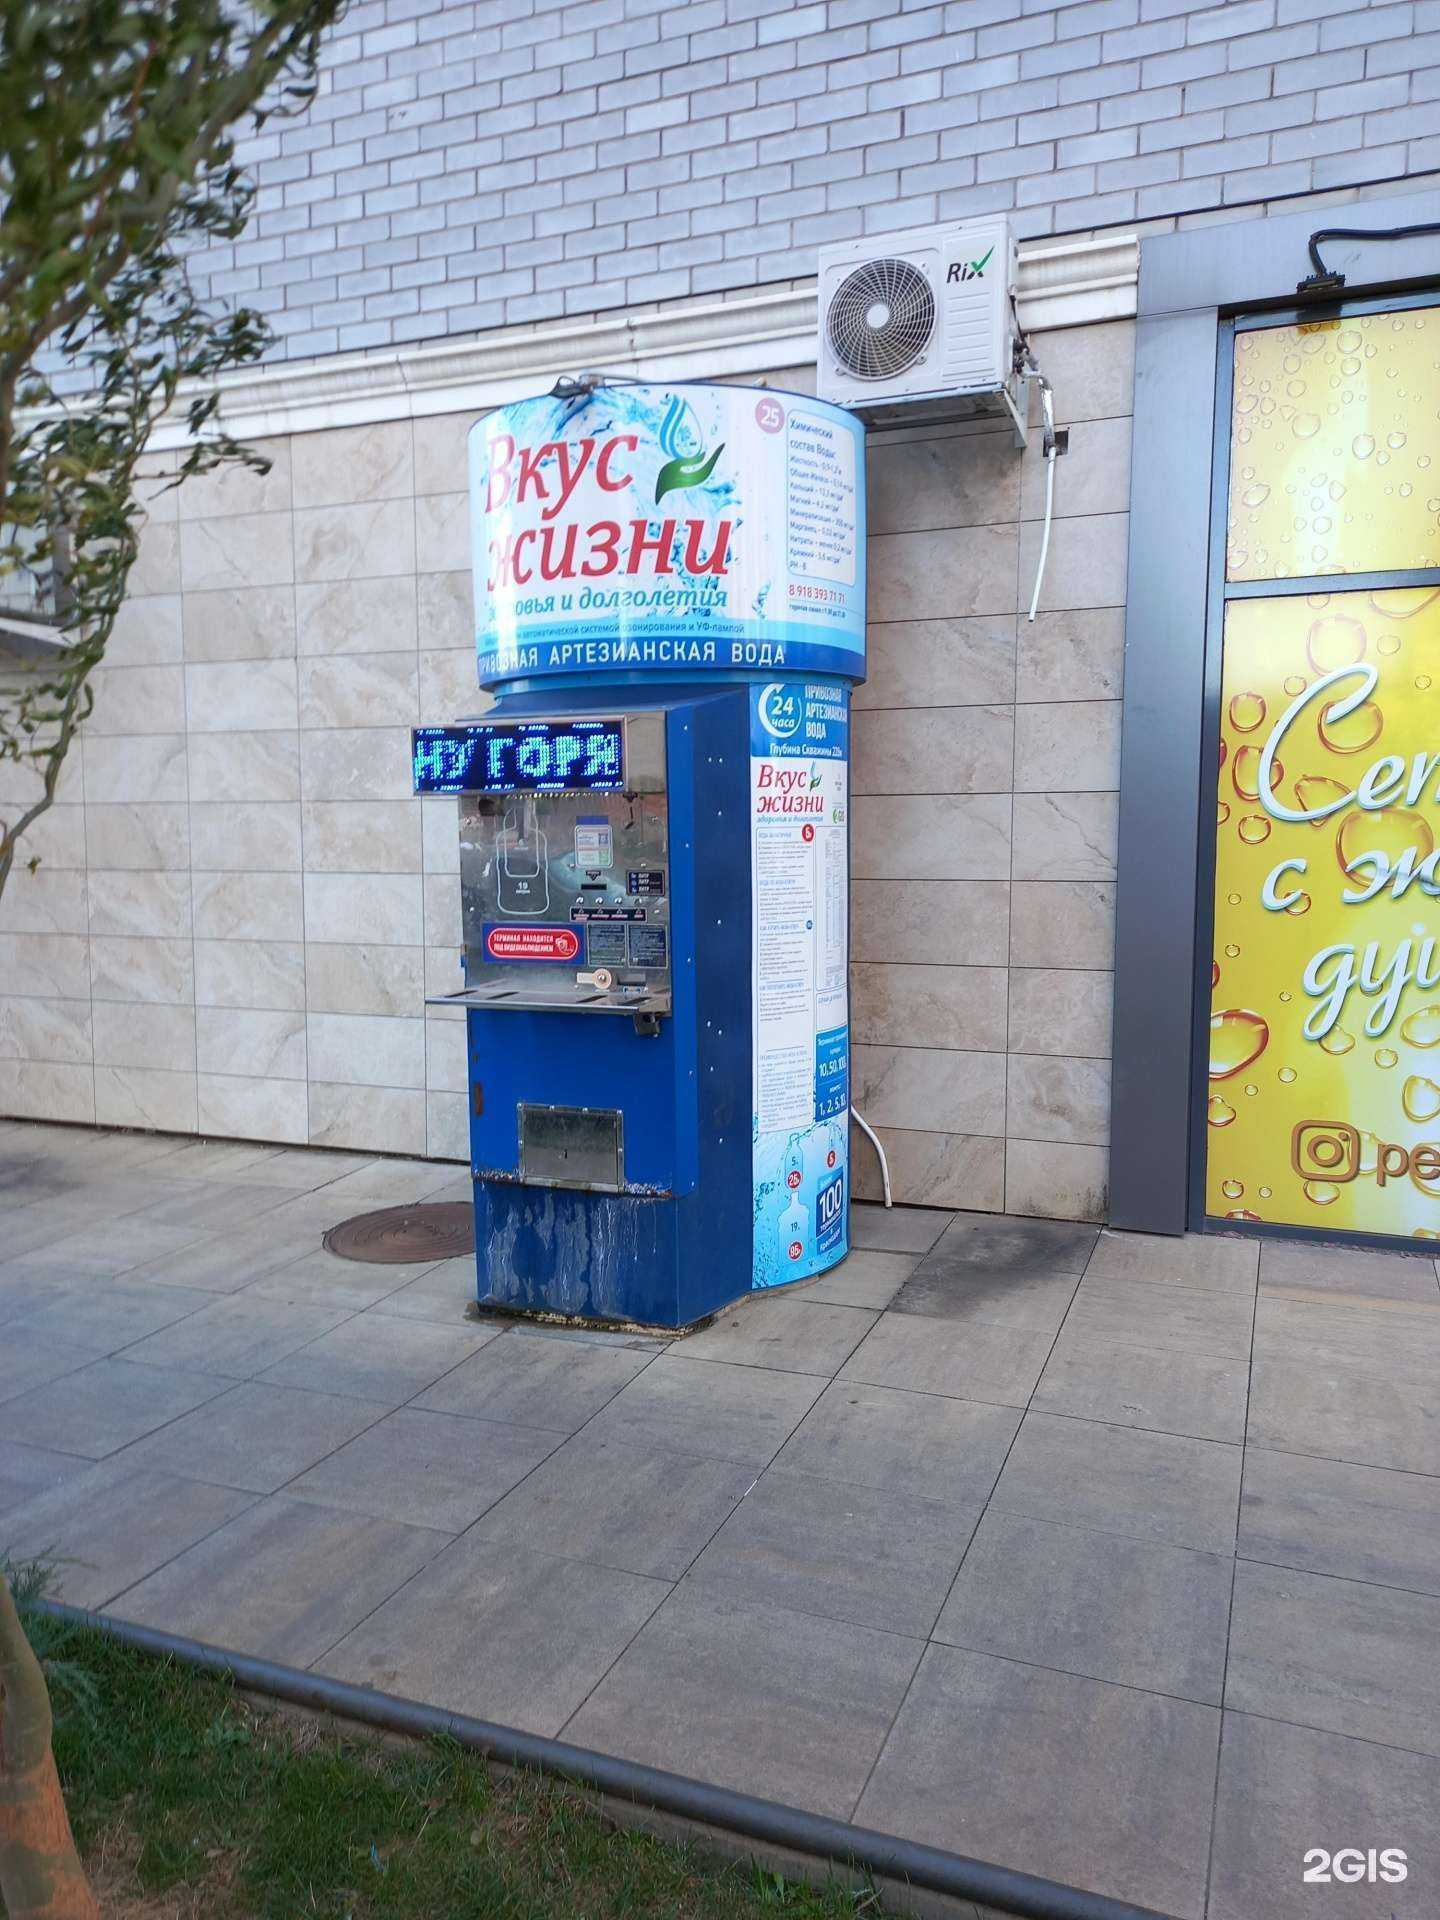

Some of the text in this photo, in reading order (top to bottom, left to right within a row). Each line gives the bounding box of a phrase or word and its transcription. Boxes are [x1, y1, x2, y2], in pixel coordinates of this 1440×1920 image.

[761, 405, 780, 428] 25
[485, 433, 639, 521] Вкус
[487, 518, 732, 592] жизни
[561, 594, 573, 611] и
[579, 586, 728, 609] долголетия
[789, 584, 795, 596] 8
[797, 585, 812, 598] 918
[814, 587, 828, 601] 393
[580, 622, 619, 634] системой
[687, 624, 695, 632] и
[549, 640, 716, 666] АРТЕЗИАНСКАЯ
[731, 642, 785, 666] ВОДА
[771, 696, 795, 716] 24
[772, 718, 795, 729] часа
[806, 722, 827, 740] ВОДА
[769, 743, 800, 757] Глубина
[757, 764, 807, 795] Вкус
[757, 794, 824, 814] жизни
[1261, 857, 1308, 912] с
[819, 1178, 842, 1223] 100
